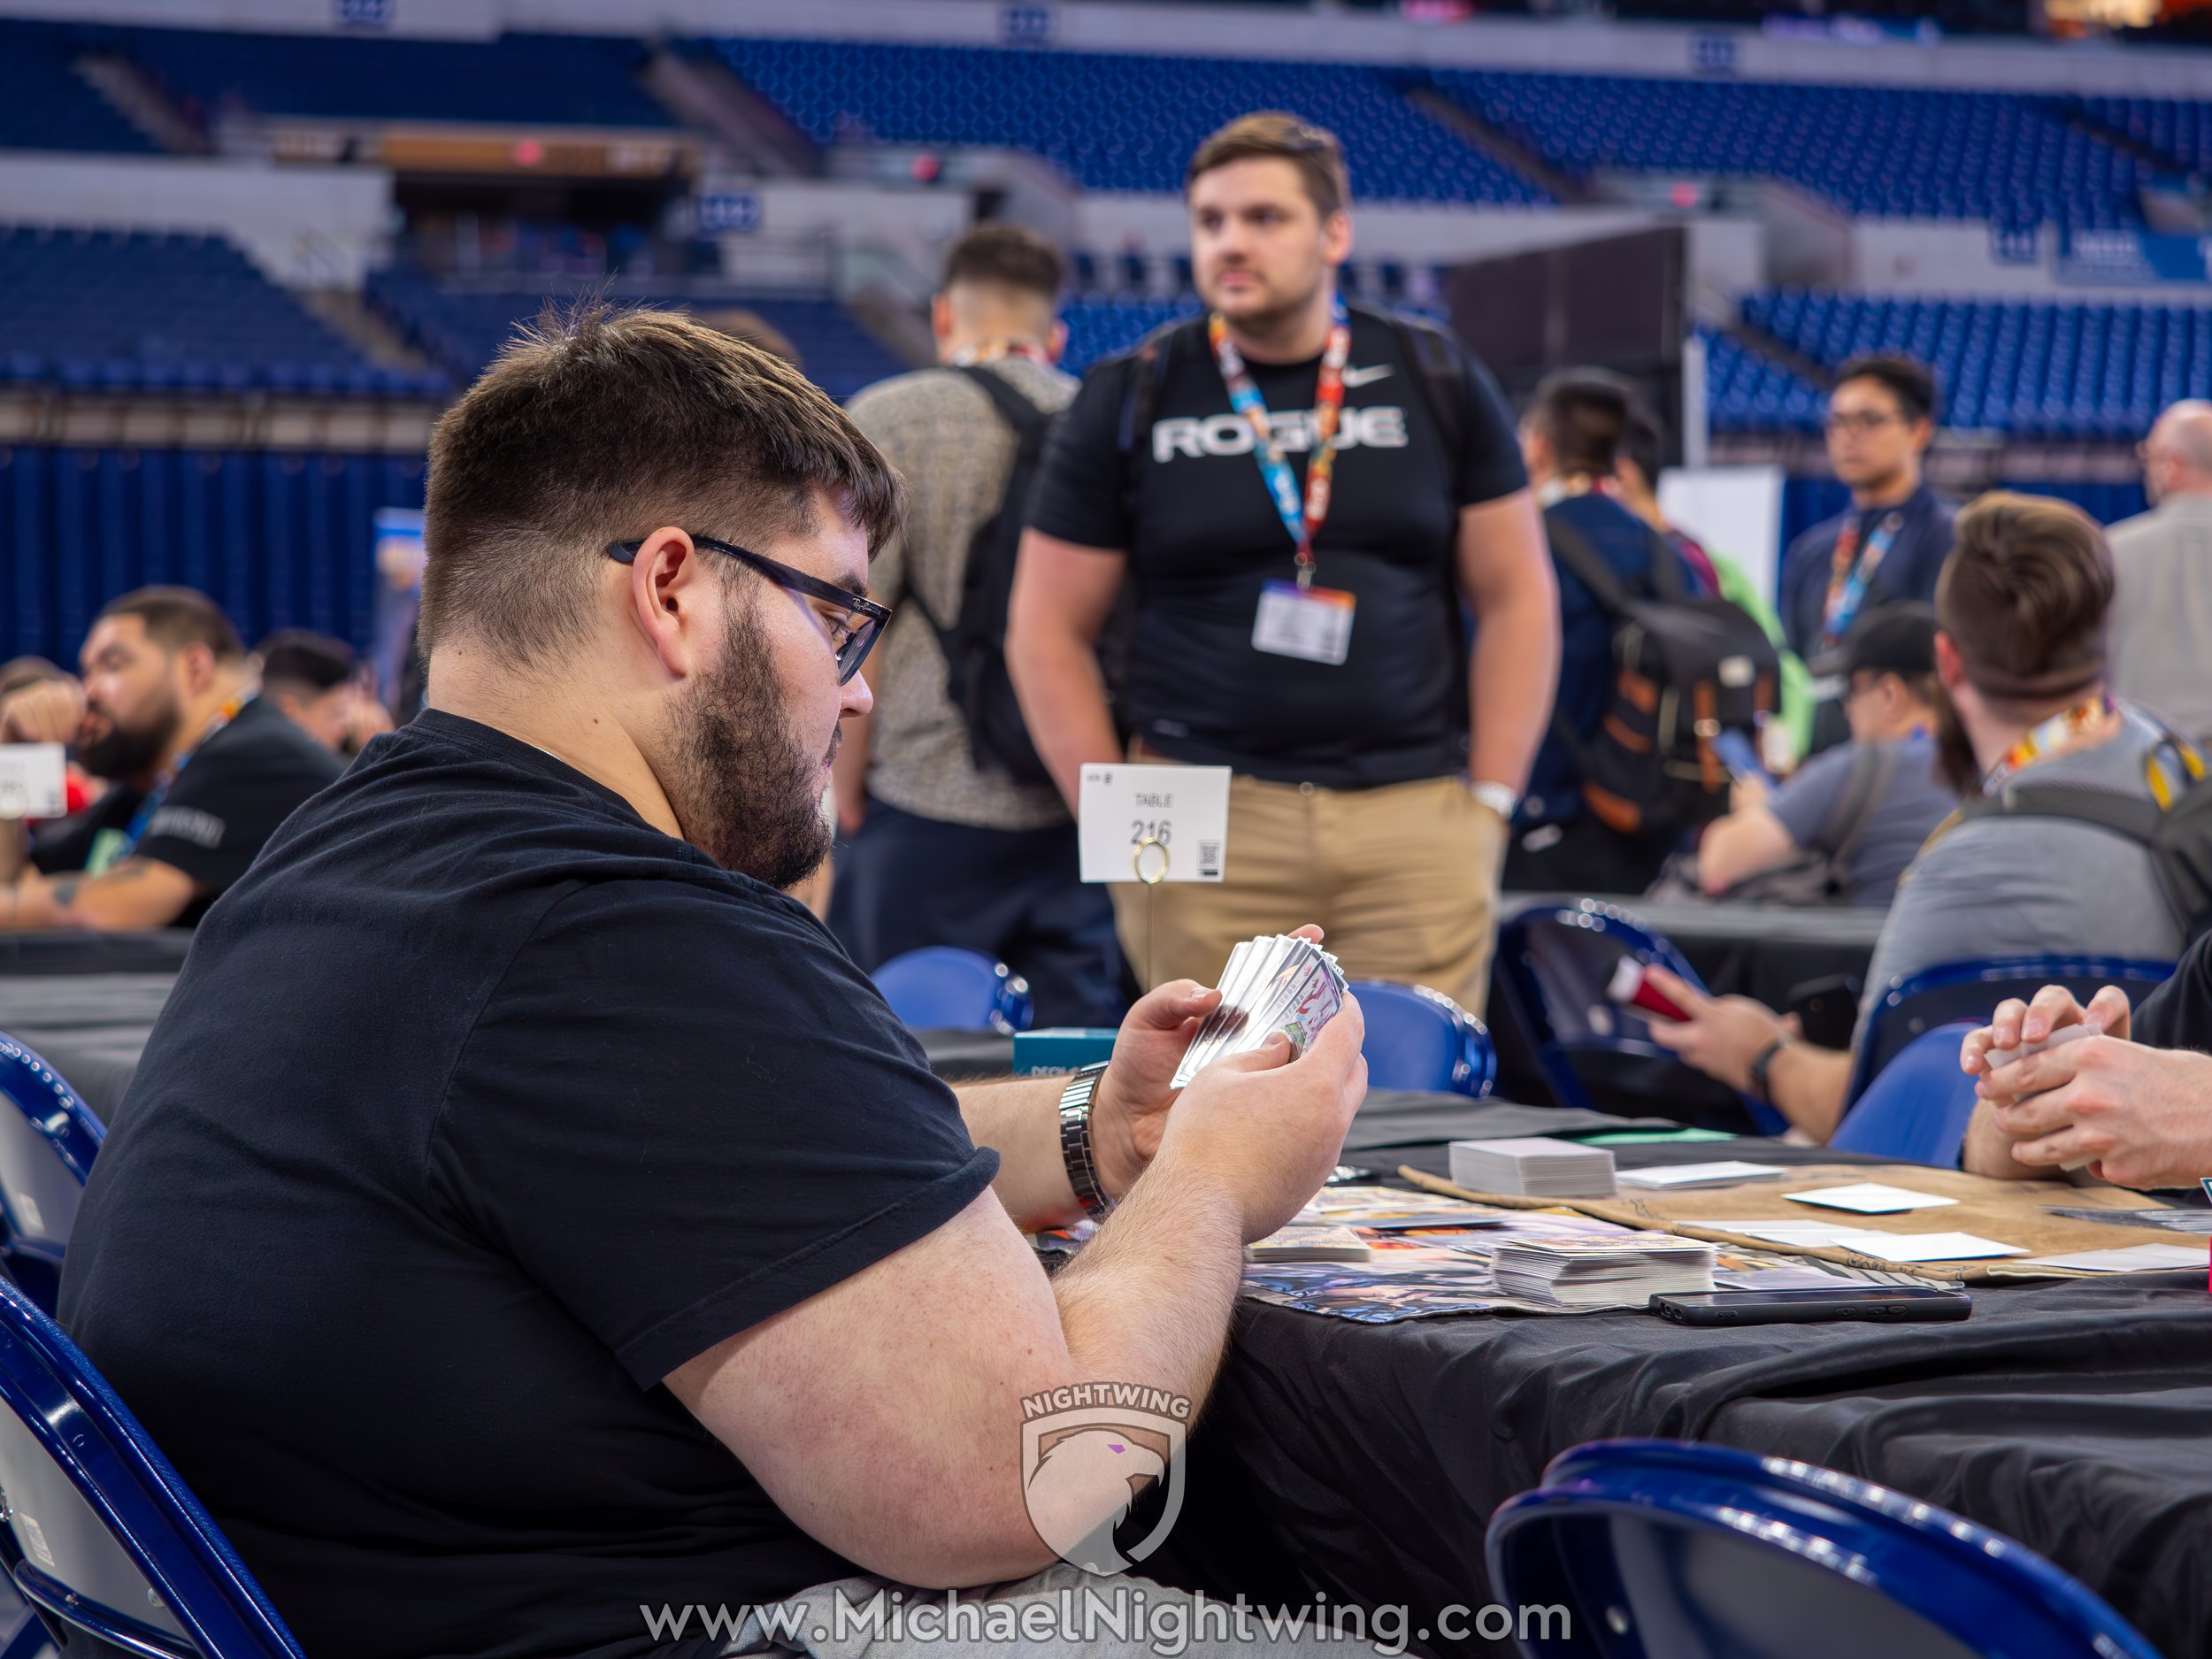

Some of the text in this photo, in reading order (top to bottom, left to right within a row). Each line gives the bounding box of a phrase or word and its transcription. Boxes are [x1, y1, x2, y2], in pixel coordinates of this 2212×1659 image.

[1152, 406, 1409, 464] ROGUE
[1135, 793, 1172, 807] TABLE
[1132, 819, 1172, 845] 216
